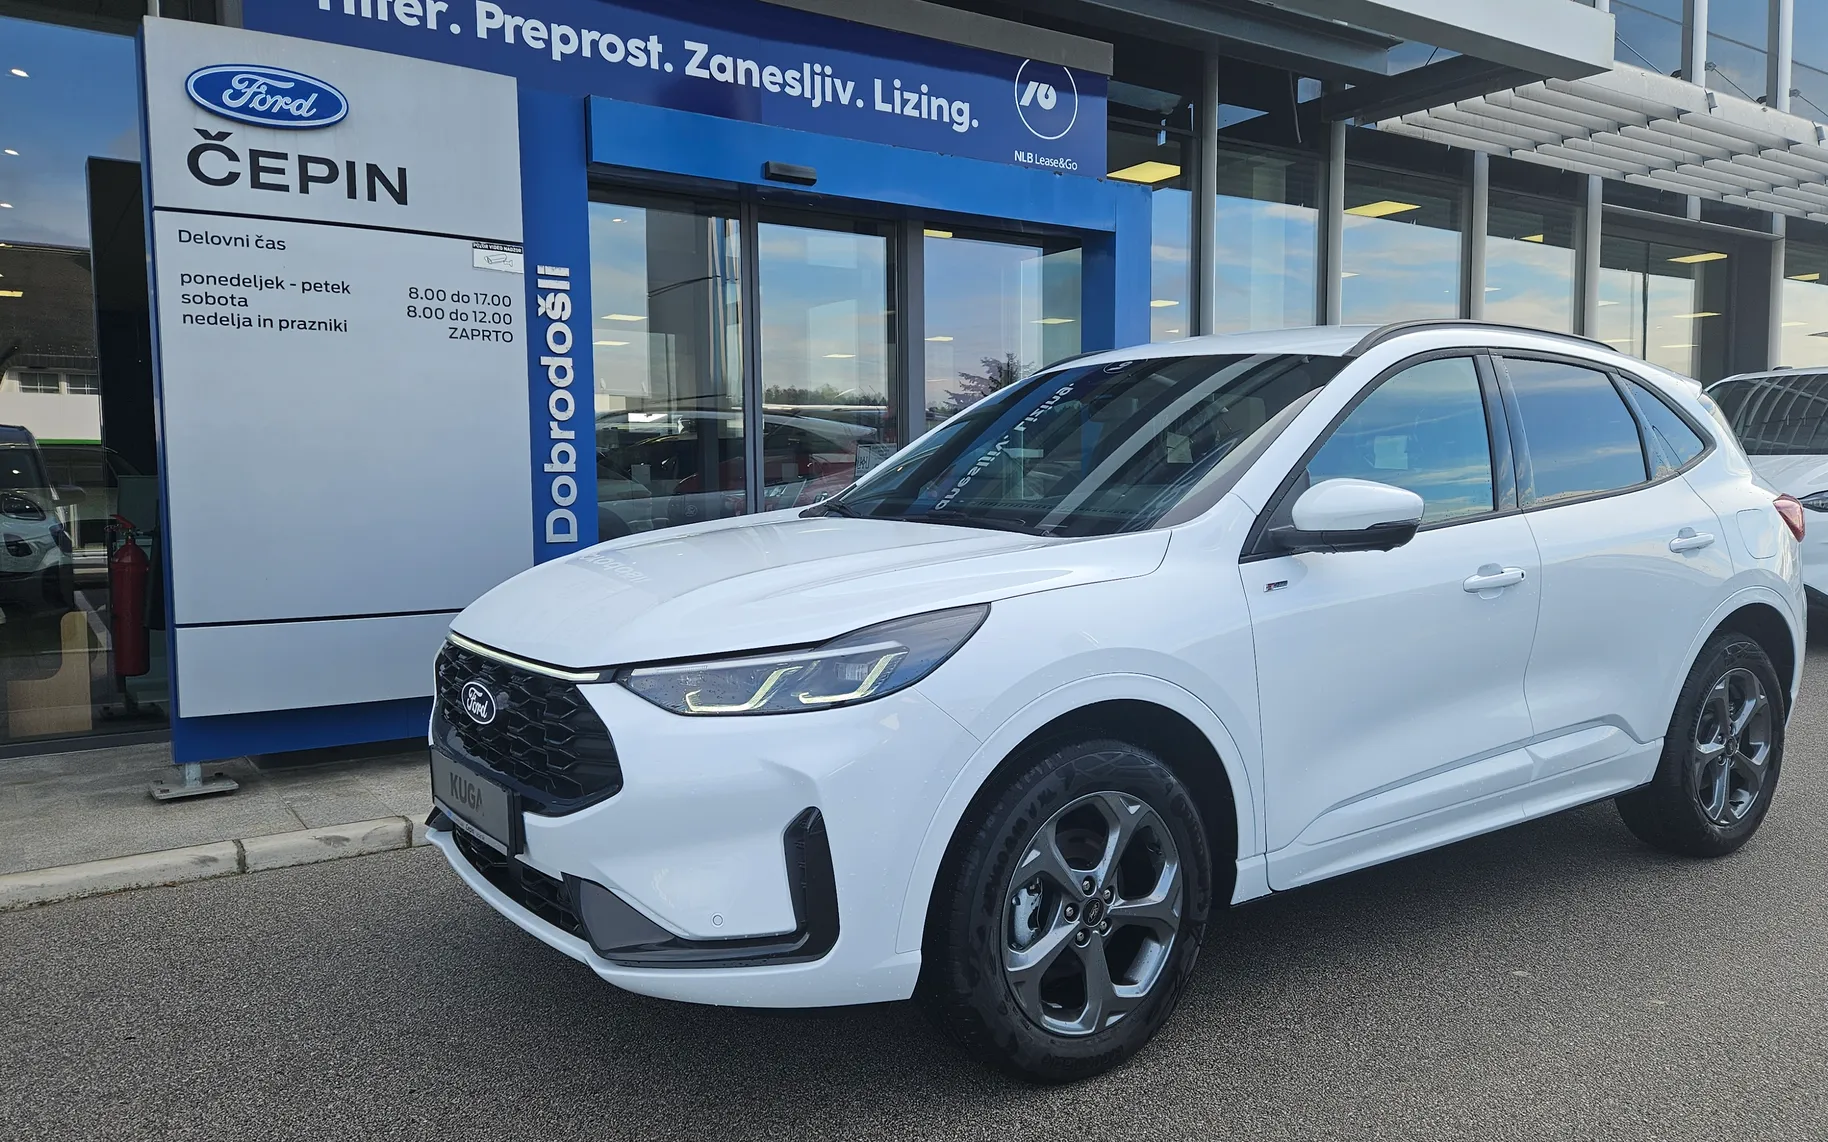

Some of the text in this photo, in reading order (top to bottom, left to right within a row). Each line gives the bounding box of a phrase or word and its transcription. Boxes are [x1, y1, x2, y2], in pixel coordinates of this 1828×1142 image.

[476, 0, 674, 73] Preprost.
[684, 40, 864, 108] Zanesljiv.
[874, 78, 979, 133] Lizing.
[222, 73, 318, 118] Ford
[187, 128, 408, 206] ČEPIN
[1014, 150, 1078, 171] NLB Lease&Go
[178, 229, 286, 250] Delovni čas
[180, 273, 285, 290] ponedeljek
[301, 281, 351, 294] petek
[181, 291, 249, 307] sobota
[408, 287, 512, 308] 8.00 do 17.00
[182, 312, 348, 333] nedelja in prazniki
[407, 305, 513, 326] 8.00 do 12.00
[448, 326, 514, 343] ZAPRTO
[536, 264, 578, 543] Dobrodošli
[466, 686, 489, 719] Ford
